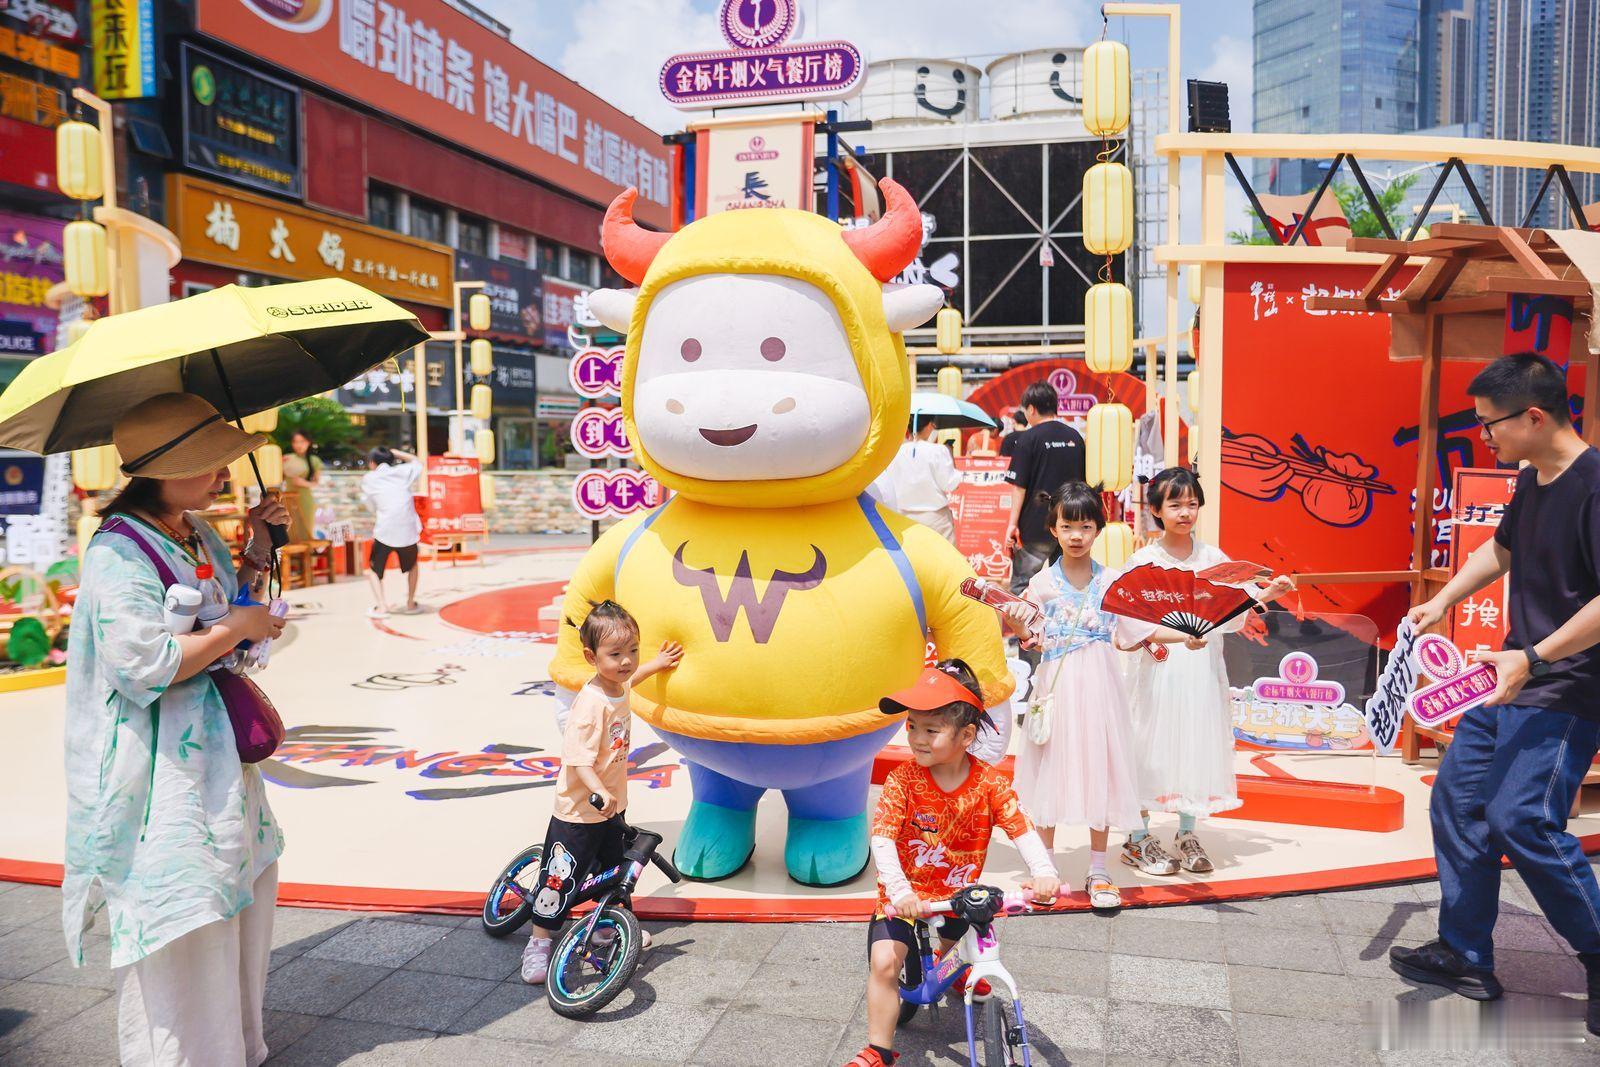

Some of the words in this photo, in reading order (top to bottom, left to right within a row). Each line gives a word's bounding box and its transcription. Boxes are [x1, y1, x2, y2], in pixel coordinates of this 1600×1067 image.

[676, 52, 843, 93] 金标牛烟火气餐厅榜
[484, 60, 579, 165] 馋大嘴巴
[287, 299, 373, 316] STRIDER
[1464, 502, 1510, 523] 打
[1264, 686, 1334, 701] 金标牛烟火气餐厅榜
